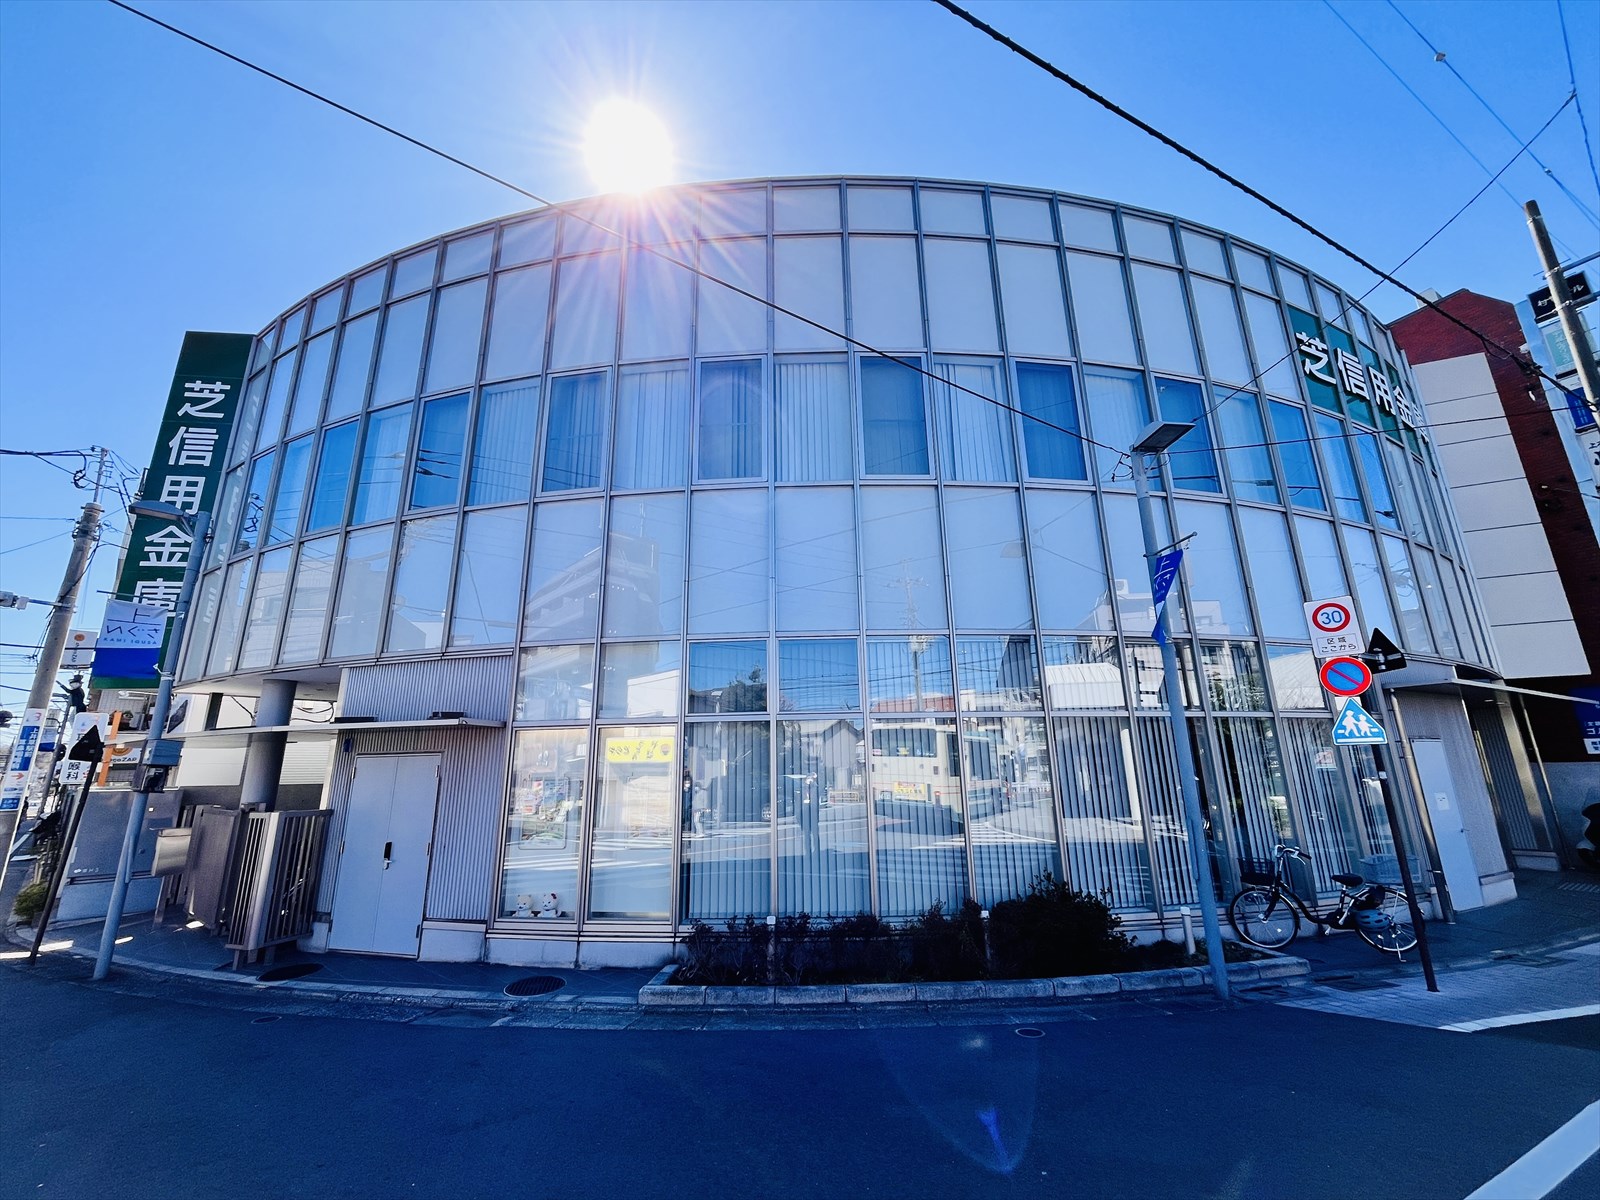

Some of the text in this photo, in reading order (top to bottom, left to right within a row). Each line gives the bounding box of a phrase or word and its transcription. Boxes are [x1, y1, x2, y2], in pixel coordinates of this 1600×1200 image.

[1320, 610, 1343, 625] 30
[1326, 636, 1347, 645] 区域
[1321, 643, 1357, 653] ここから
